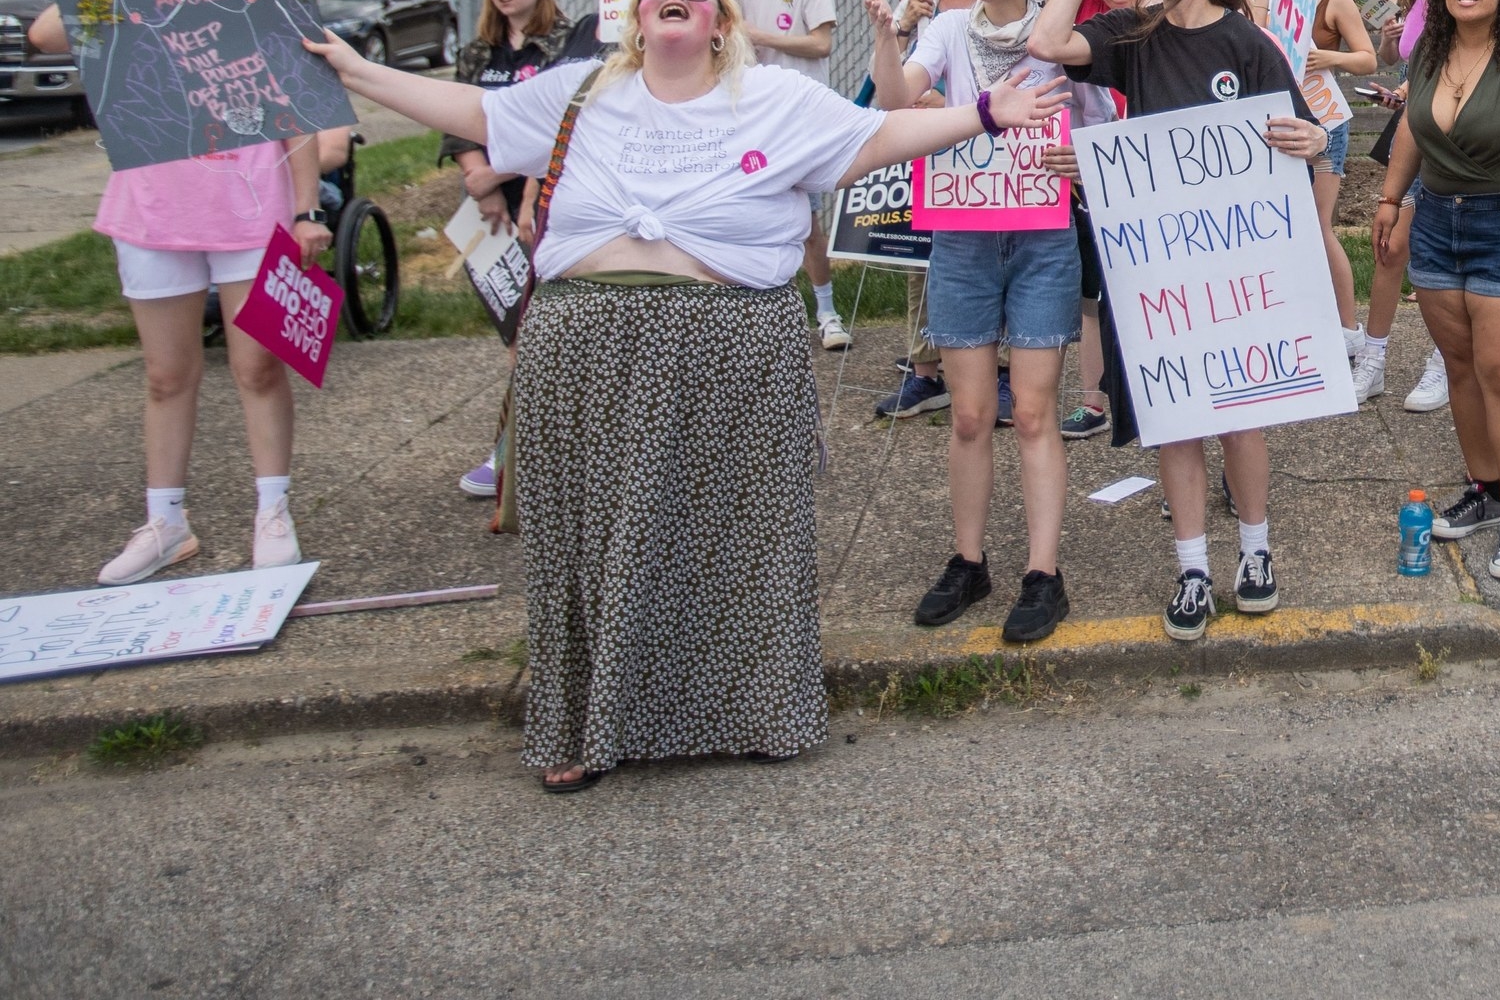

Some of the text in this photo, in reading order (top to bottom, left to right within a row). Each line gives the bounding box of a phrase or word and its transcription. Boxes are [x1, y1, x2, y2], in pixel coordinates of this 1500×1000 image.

[162, 20, 223, 55] KEEP
[178, 49, 224, 74] YOUR
[188, 75, 260, 107] OFF MY
[1302, 74, 1344, 124] ODY
[618, 126, 736, 140] If I wanted the
[622, 139, 725, 155] government
[657, 166, 668, 174] a
[1092, 113, 1274, 208] MY BODY
[931, 171, 1060, 207] BUSINESS
[854, 213, 880, 228] FOR
[880, 210, 902, 225] U.S.
[868, 231, 931, 243] CHARLESBOOKER.ORG
[1100, 194, 1292, 269] MY PRIVACY
[263, 270, 328, 339] OFF OUR
[275, 254, 332, 320] BODIES
[1139, 270, 1285, 340] MY LIFE
[281, 315, 323, 363] BANS
[1139, 336, 1317, 408] MY CHOICE
